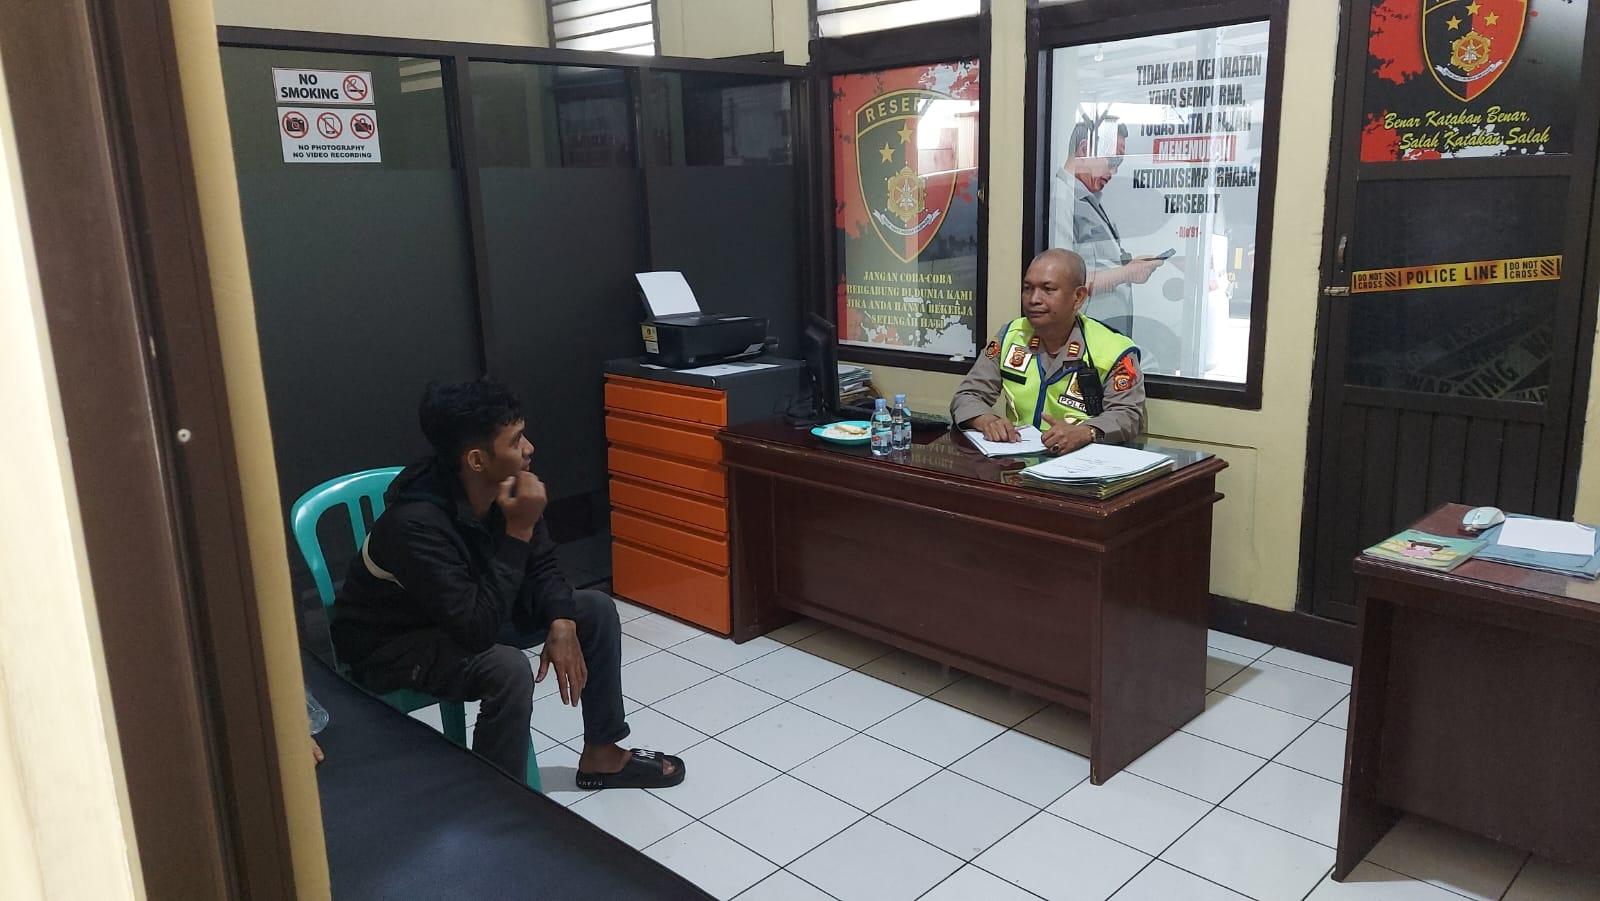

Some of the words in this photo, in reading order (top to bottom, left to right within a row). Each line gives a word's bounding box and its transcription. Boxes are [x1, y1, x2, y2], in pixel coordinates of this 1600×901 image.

[299, 73, 318, 85] NO
[1136, 62, 1170, 86] TIDAK
[1171, 60, 1194, 83] ADA
[281, 87, 339, 99] SMOKING
[1384, 113, 1421, 129] Benar
[1425, 109, 1482, 127] Katakan
[1486, 106, 1531, 124] Benar,
[1400, 132, 1440, 150] Salah
[1506, 126, 1551, 145] Salah
[1509, 262, 1520, 270] DO
[1522, 261, 1538, 269] NOT
[864, 271, 898, 282] JANGAN
[900, 272, 953, 285] COBA-COBA
[1369, 273, 1383, 281] NOT
[1406, 268, 1457, 285] POLICE
[1464, 265, 1498, 281] LINE
[1509, 269, 1538, 279] CROSS
[1358, 280, 1383, 289] CROSS
[847, 284, 899, 297] BERGABUNG
[901, 287, 912, 297] DI
[914, 287, 944, 299] DUNIA
[946, 289, 973, 301] KAMI
[847, 298, 867, 309] JIKA
[869, 300, 892, 311] ANDA
[894, 301, 926, 313] HANYA
[928, 303, 973, 316] BEKERJA
[871, 314, 919, 327] SETENGAH
[920, 318, 945, 329] HARI
